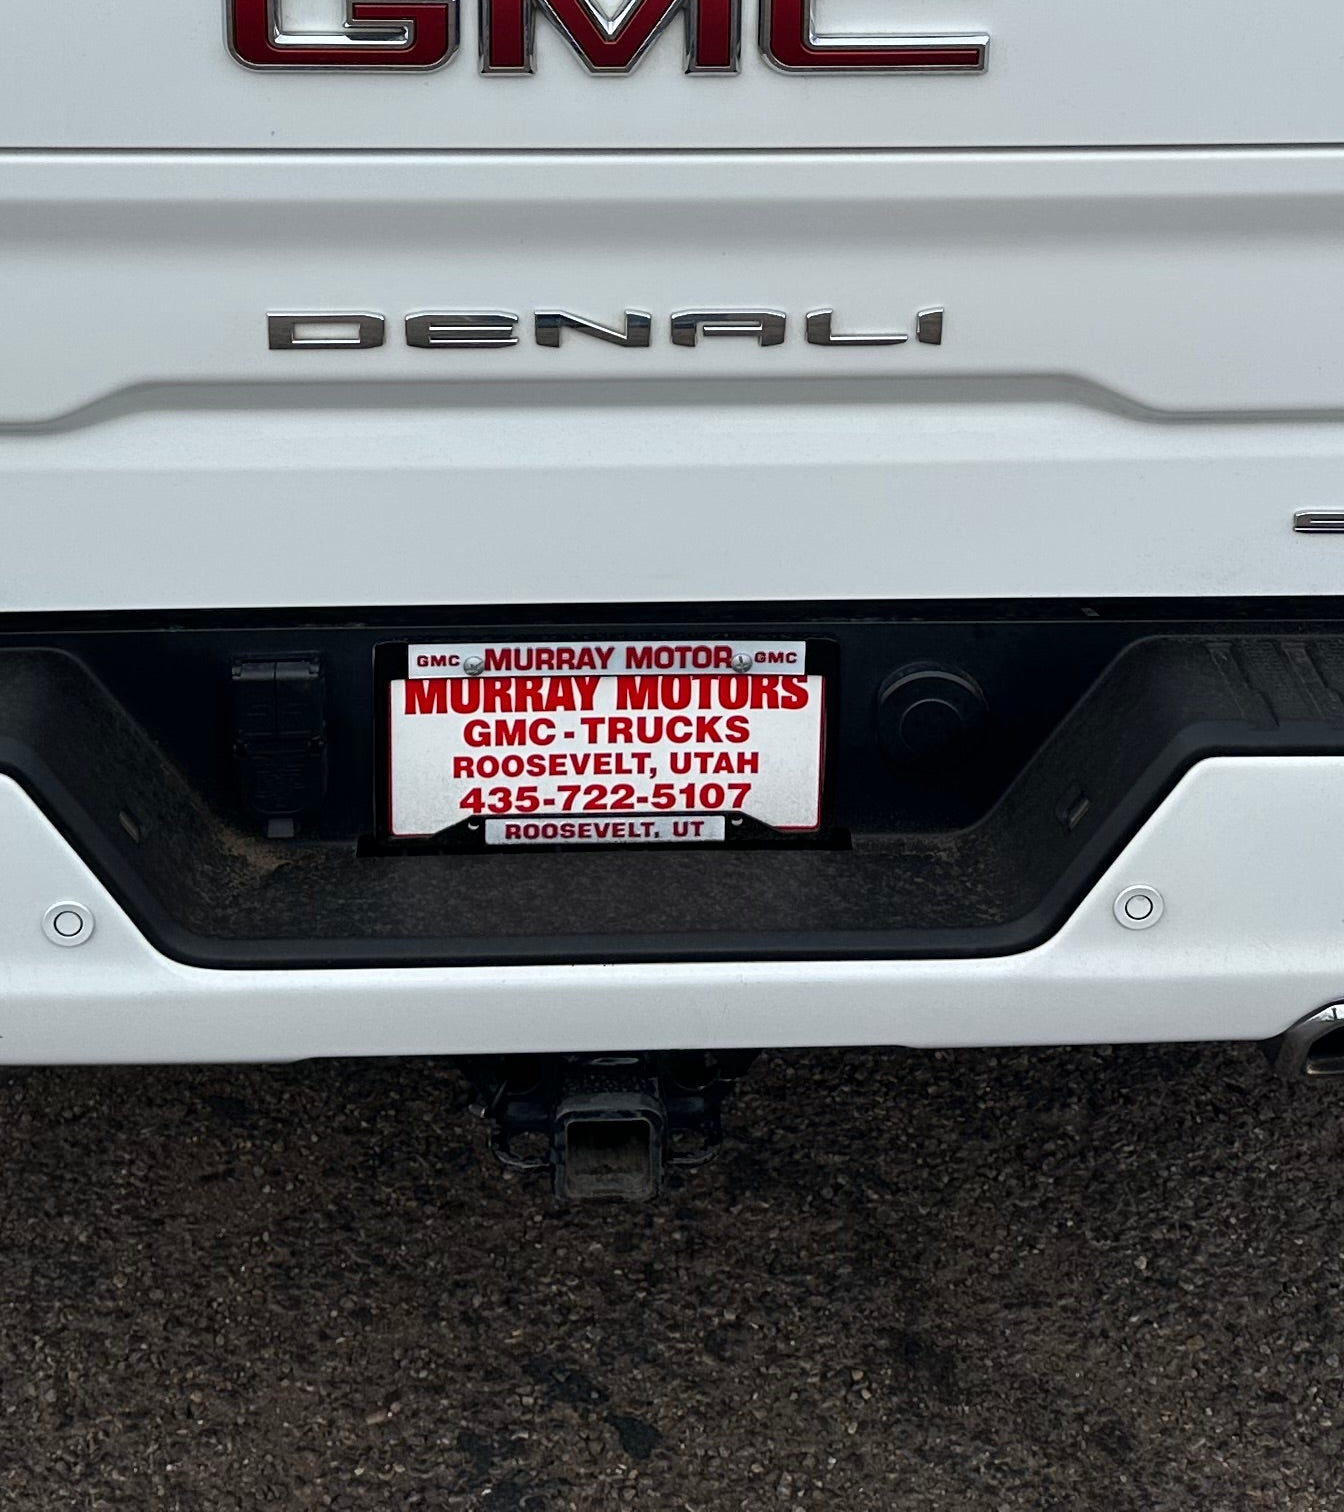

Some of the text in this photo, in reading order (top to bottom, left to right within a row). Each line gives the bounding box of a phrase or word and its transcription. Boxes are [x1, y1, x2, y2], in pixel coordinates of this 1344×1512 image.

[267, 307, 945, 350] DENALI
[417, 645, 797, 671] GMC MURRAY MOTOR GMC
[405, 675, 809, 714] MURRAY MOTORS
[453, 752, 759, 779] ROOSEVELT, UTAH
[459, 783, 752, 814] 435-722-5107
[672, 821, 705, 837] UT
